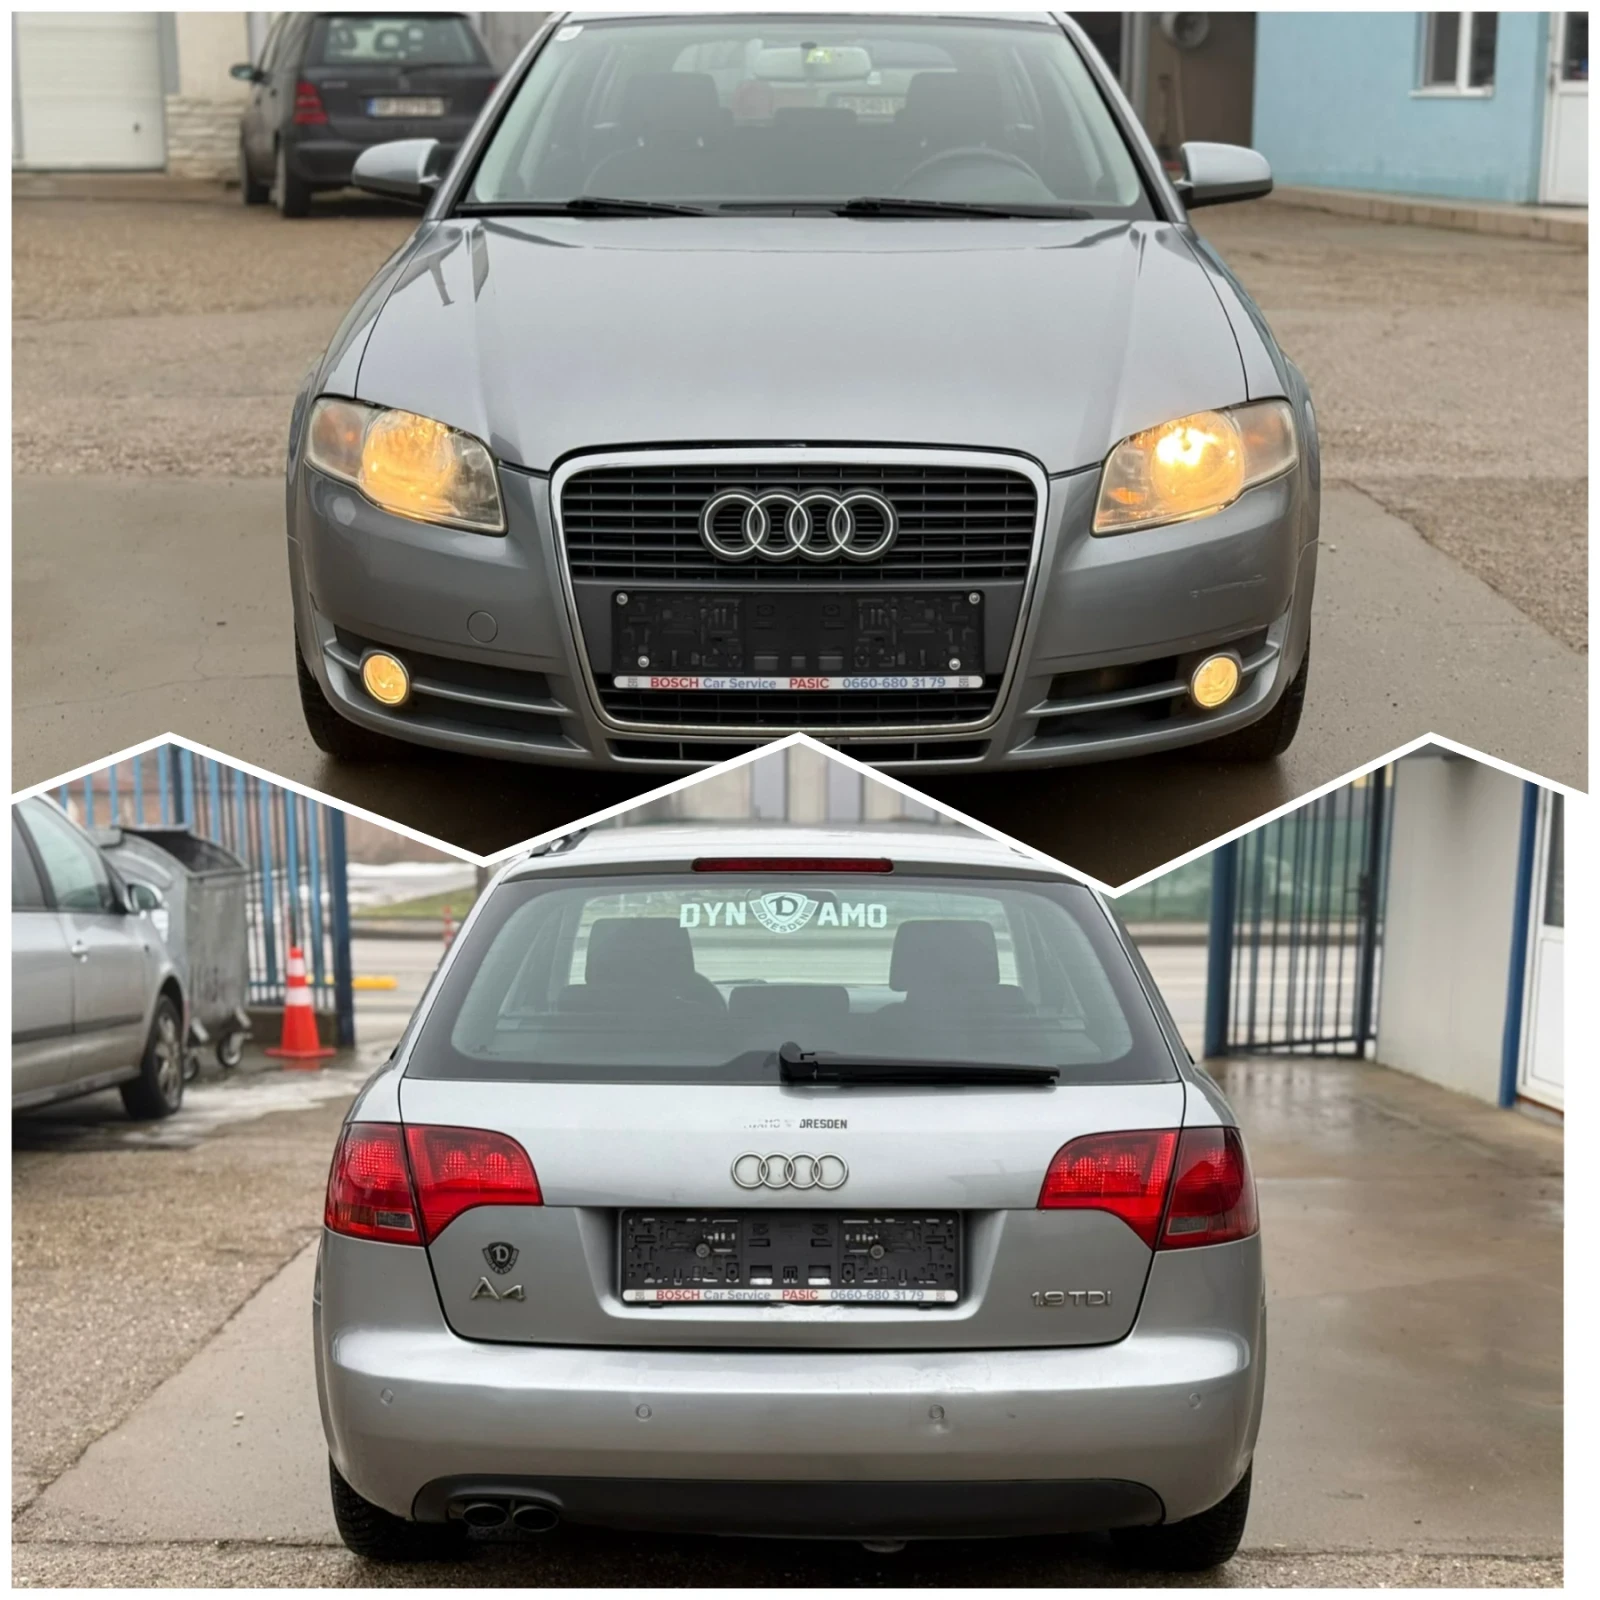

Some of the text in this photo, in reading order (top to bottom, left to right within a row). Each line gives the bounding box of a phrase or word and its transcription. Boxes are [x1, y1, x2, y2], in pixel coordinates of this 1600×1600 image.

[650, 677, 699, 688] BOSCH
[703, 677, 726, 688] Car
[729, 677, 777, 689] Service
[789, 678, 830, 689] PASIC
[842, 677, 908, 688] 0660-680
[757, 912, 812, 933] DRESDEN
[799, 1119, 848, 1129] DRESDEN
[470, 1276, 526, 1301] A4
[656, 1290, 700, 1300] BOSCH
[703, 1290, 724, 1300] Car
[727, 1290, 771, 1300] Service
[782, 1290, 819, 1300] PASIC
[830, 1290, 890, 1300] 0660-680
[1031, 1290, 1112, 1306] 1.9 TDI
